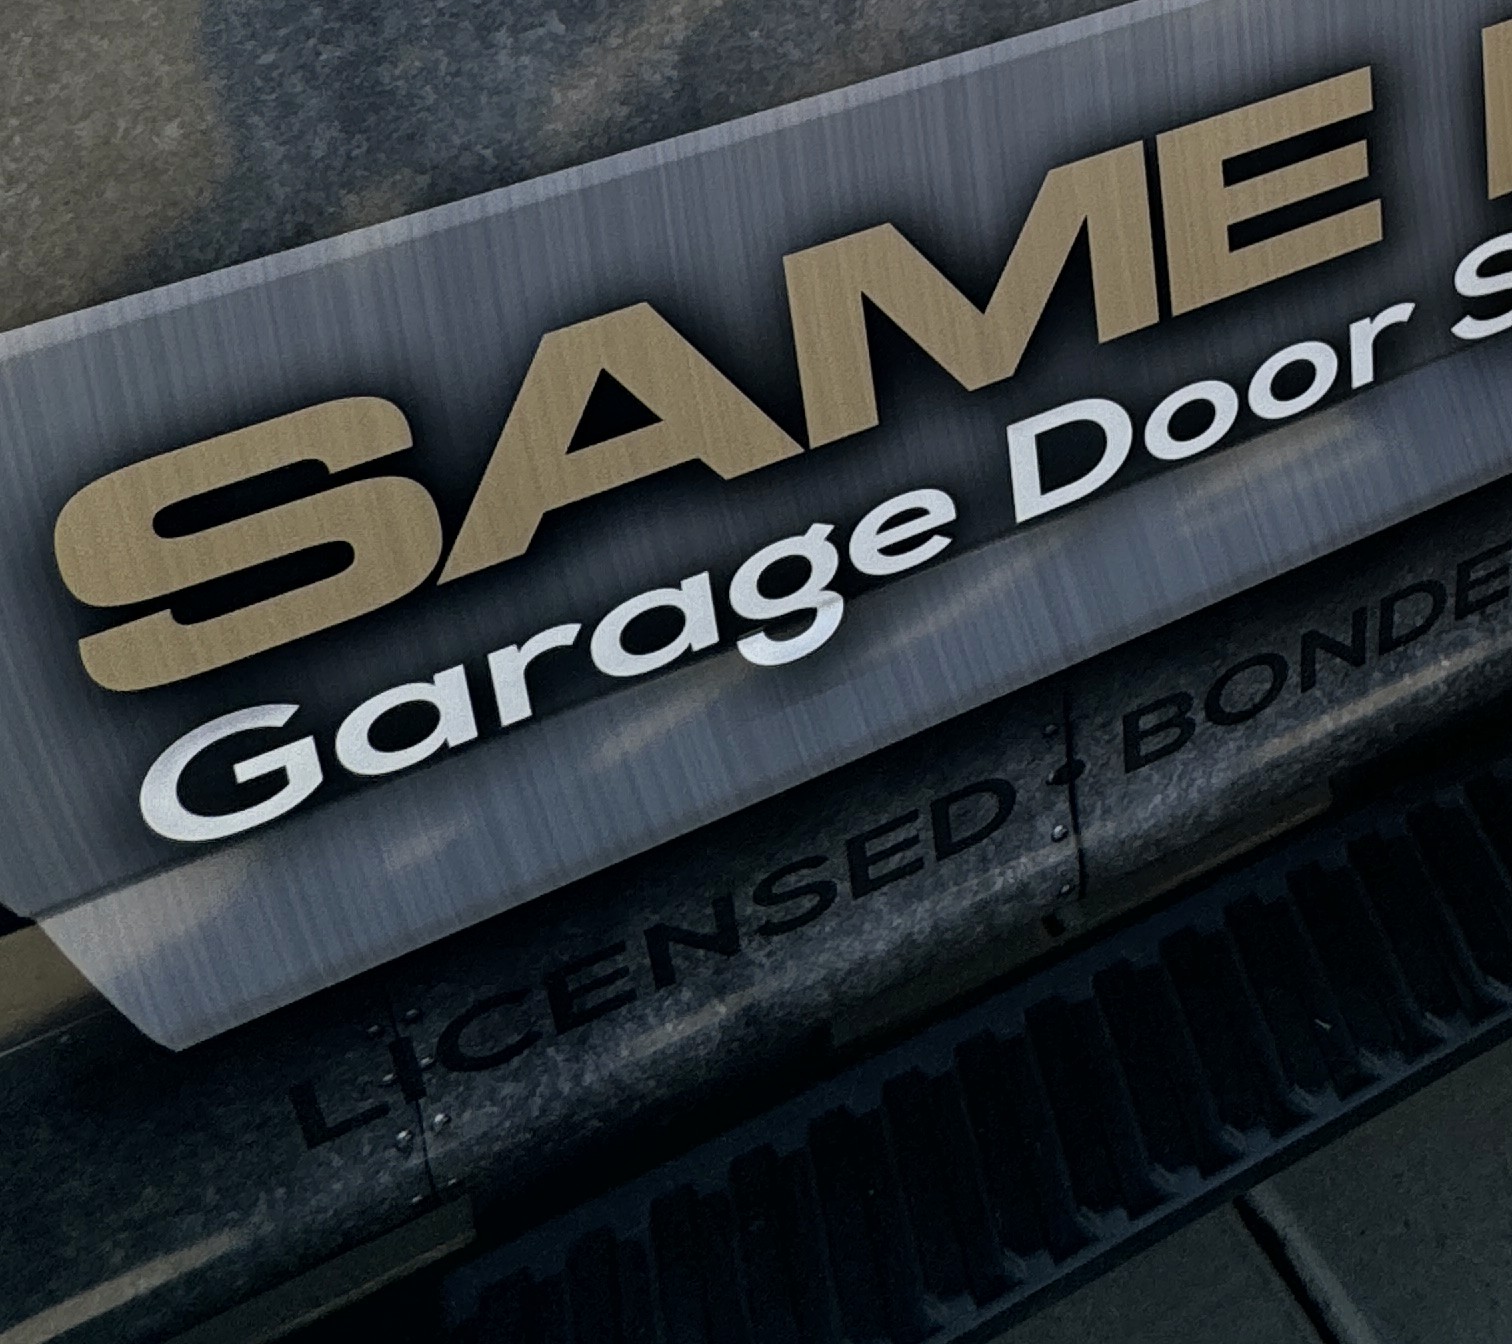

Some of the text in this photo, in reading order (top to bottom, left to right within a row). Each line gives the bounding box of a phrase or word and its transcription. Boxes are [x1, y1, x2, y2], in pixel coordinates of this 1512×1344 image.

[54, 64, 1385, 692] SAME
[138, 488, 956, 842] Garage
[1005, 298, 1416, 521] Door
[290, 777, 1017, 1149] LICENSED
